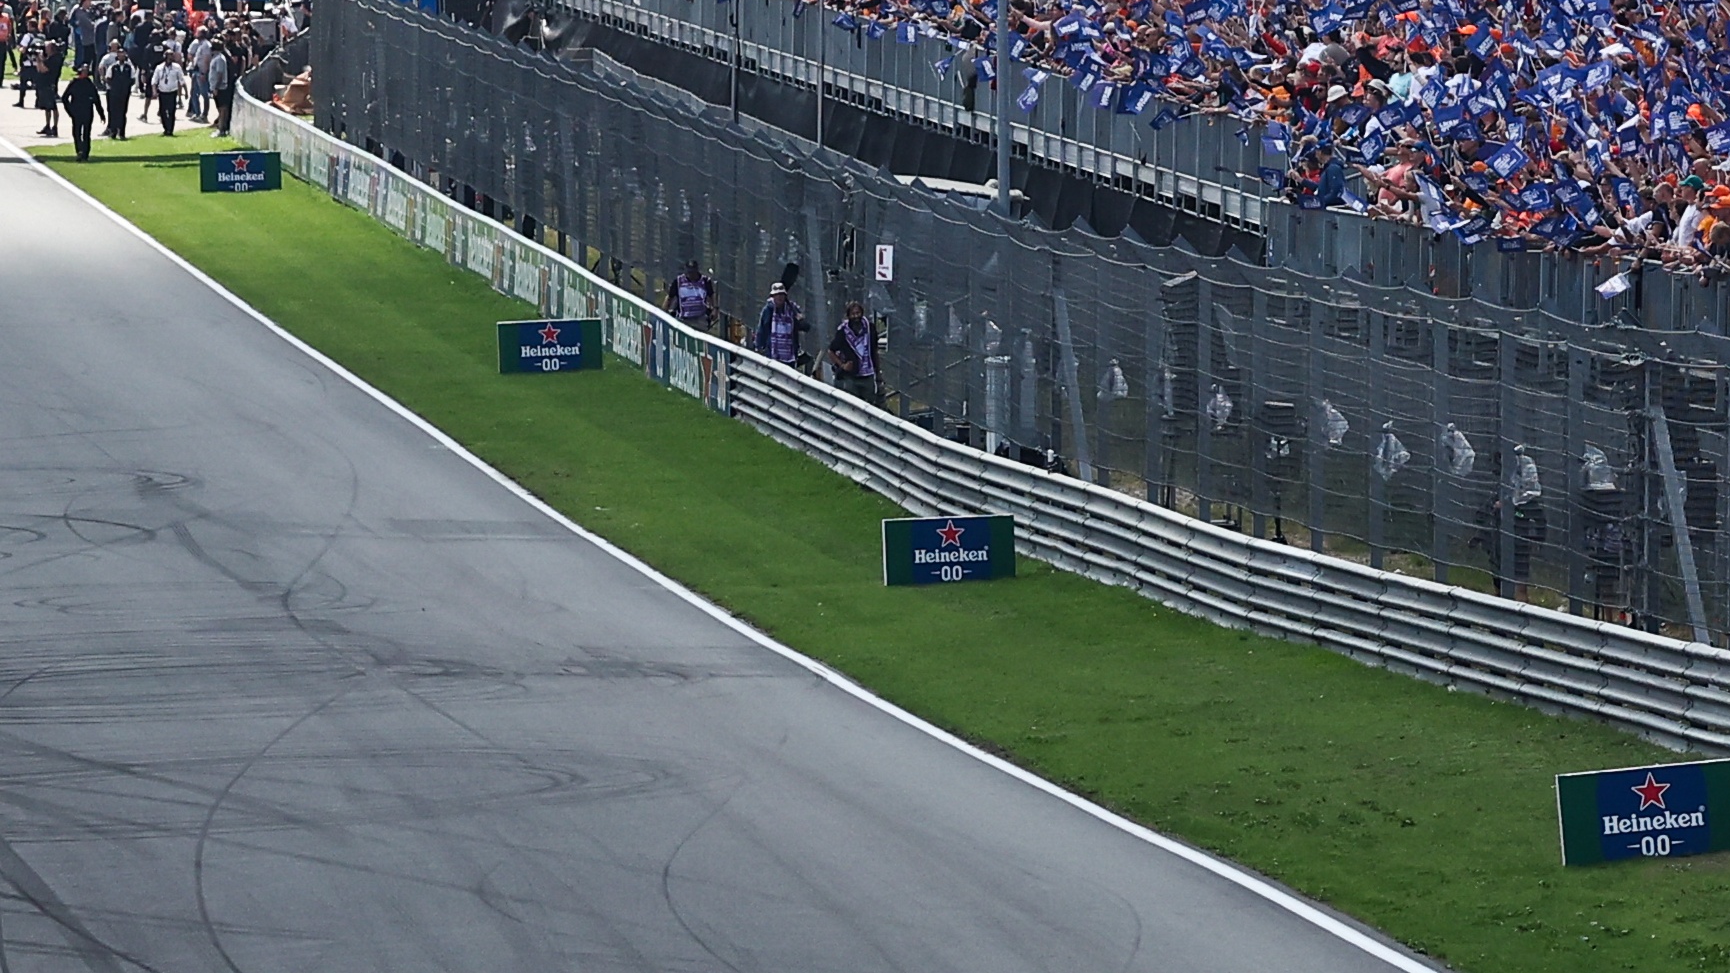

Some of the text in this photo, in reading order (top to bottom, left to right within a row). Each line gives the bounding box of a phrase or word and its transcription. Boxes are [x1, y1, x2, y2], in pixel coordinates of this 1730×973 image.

[218, 172, 264, 181] Heineken
[521, 345, 579, 357] Heineken
[914, 548, 988, 563] Heineken
[1603, 810, 1705, 835] Heineken
[1641, 835, 1670, 856] 0.0
